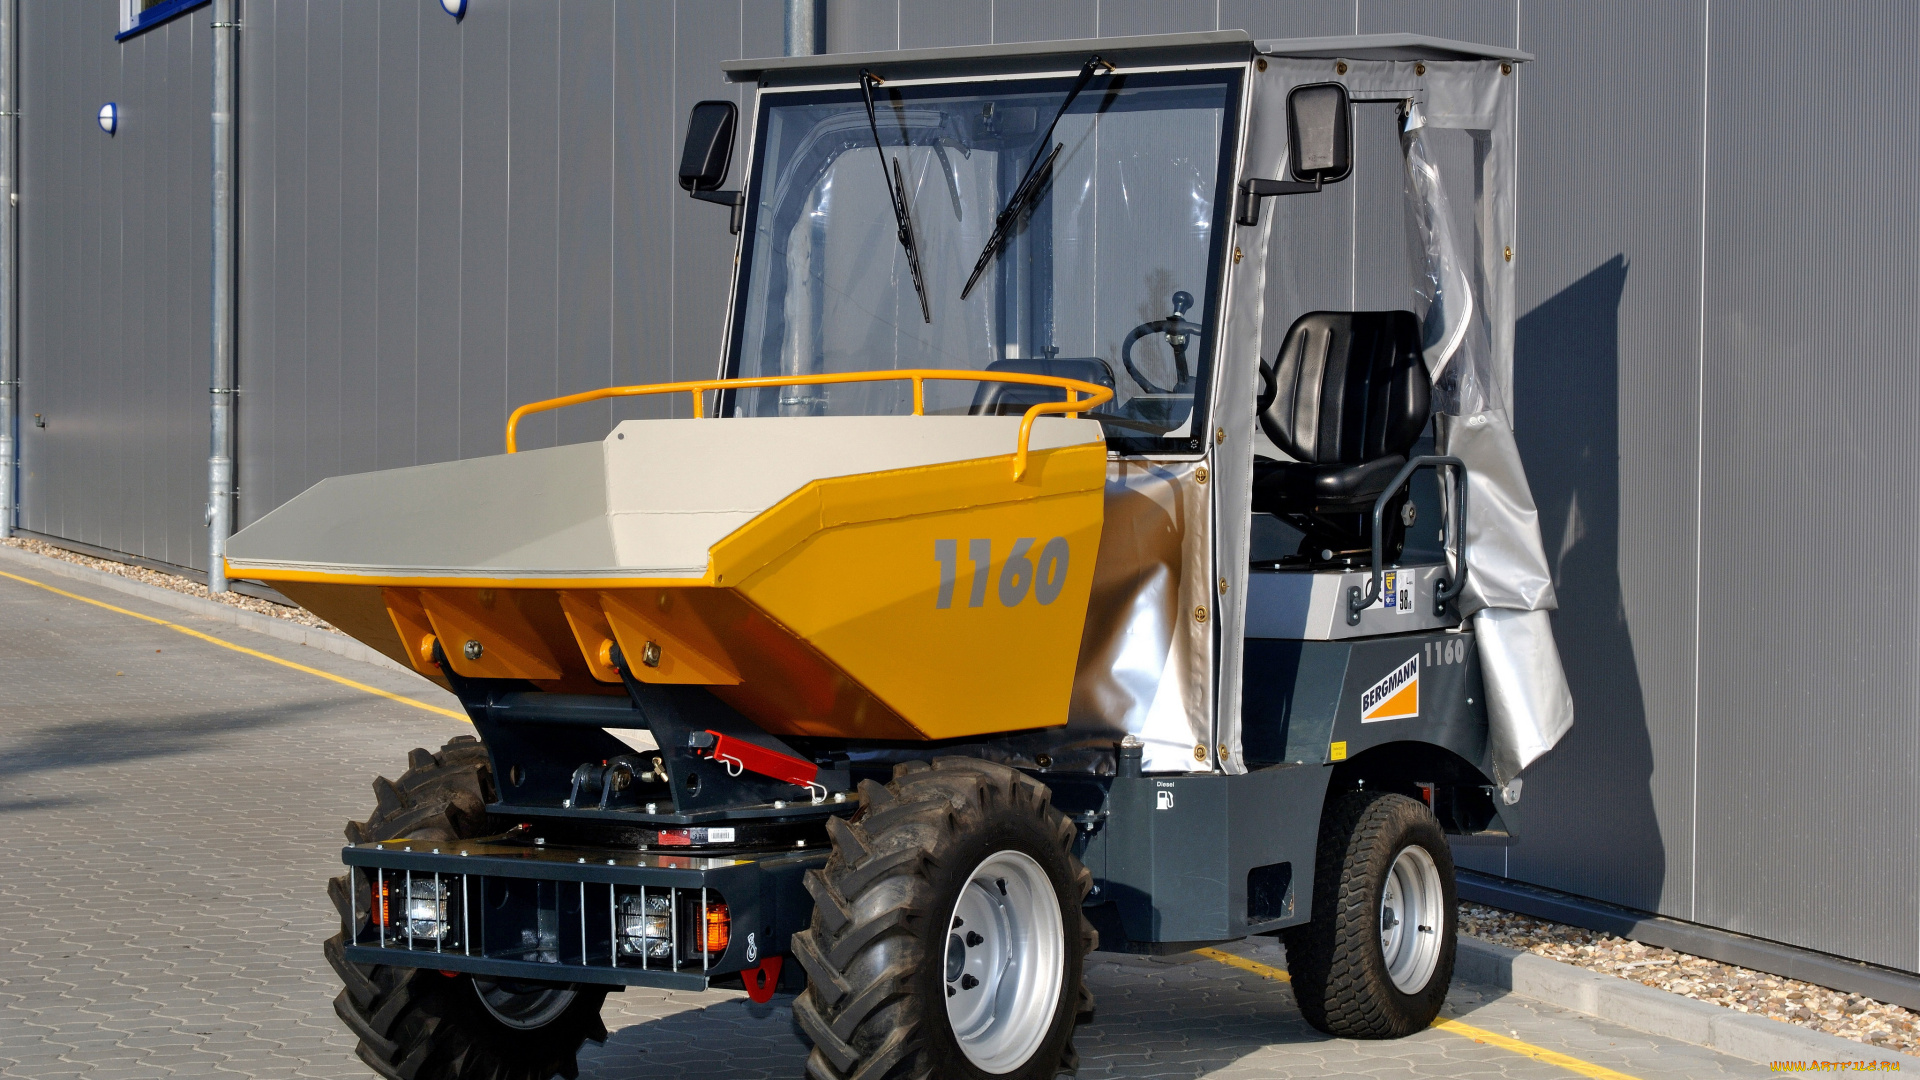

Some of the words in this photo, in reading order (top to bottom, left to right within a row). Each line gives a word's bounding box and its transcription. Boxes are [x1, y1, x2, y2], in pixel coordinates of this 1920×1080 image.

[934, 536, 1070, 609] 1160
[1424, 638, 1465, 667] 1160
[1362, 657, 1417, 713] BERGMANN
